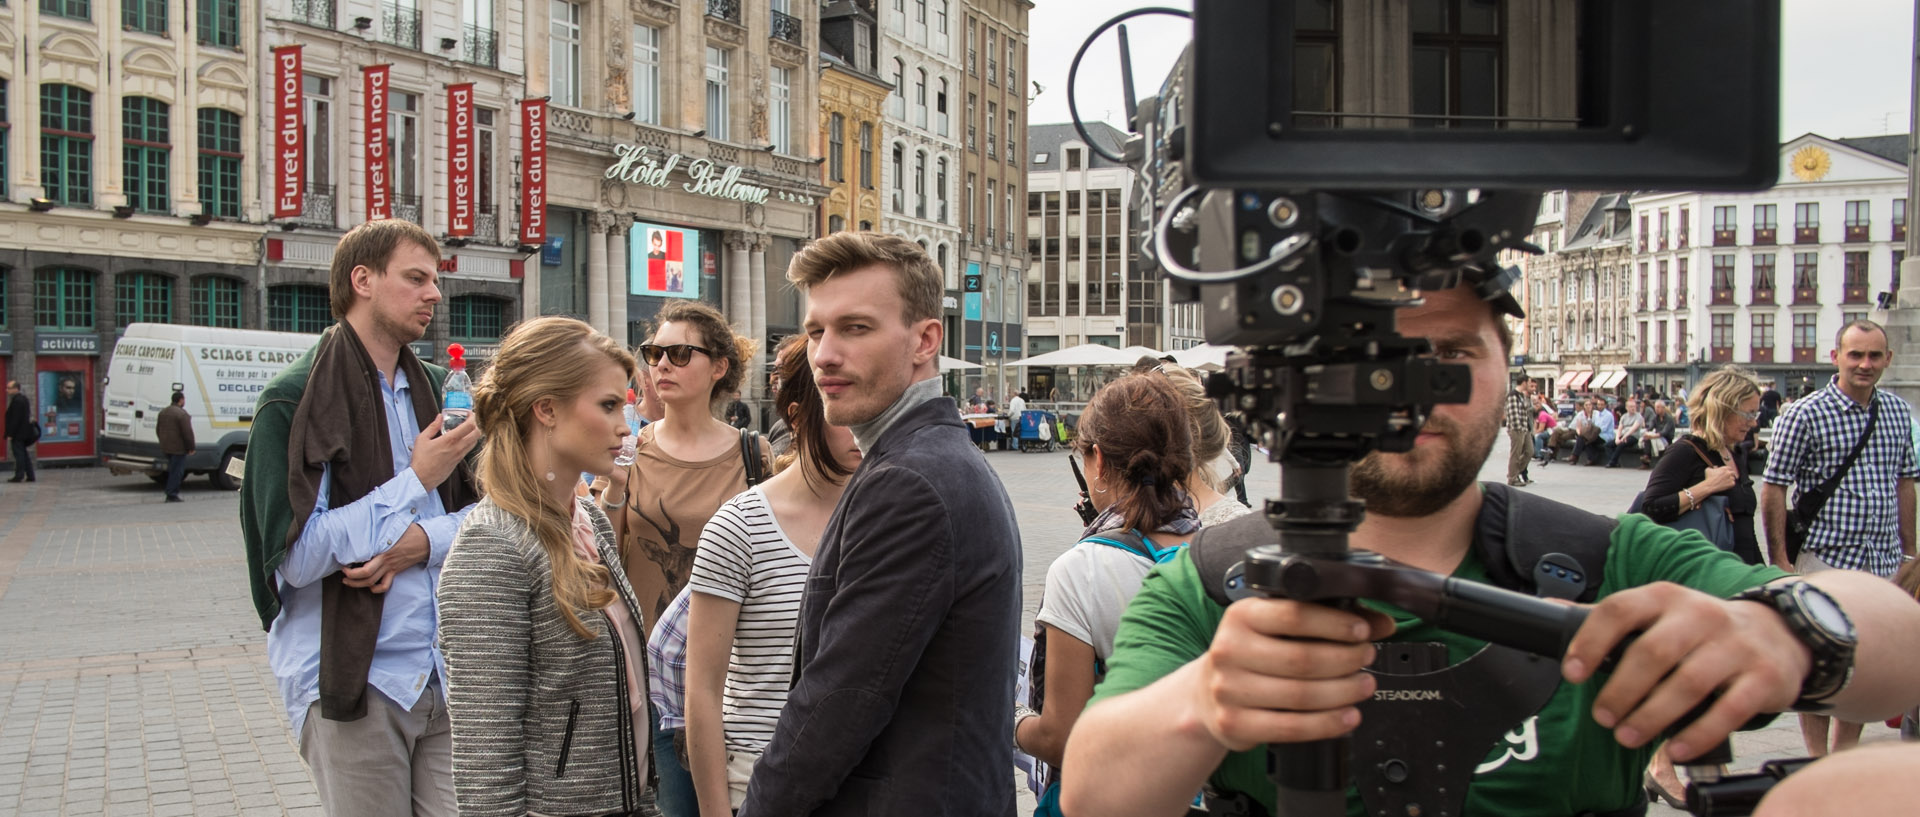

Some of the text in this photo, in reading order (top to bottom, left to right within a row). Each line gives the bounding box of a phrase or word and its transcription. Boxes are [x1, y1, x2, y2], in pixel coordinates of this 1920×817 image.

[281, 53, 298, 211] Furet du nord
[369, 71, 385, 220] Furet du nord
[453, 90, 468, 230] Furet du nord
[526, 105, 541, 239] Furet du nord
[606, 143, 770, 205] Hôtel Bellevue
[42, 338, 95, 350] activités
[116, 344, 137, 356] SCIAGE
[201, 348, 253, 362] SCIAGE
